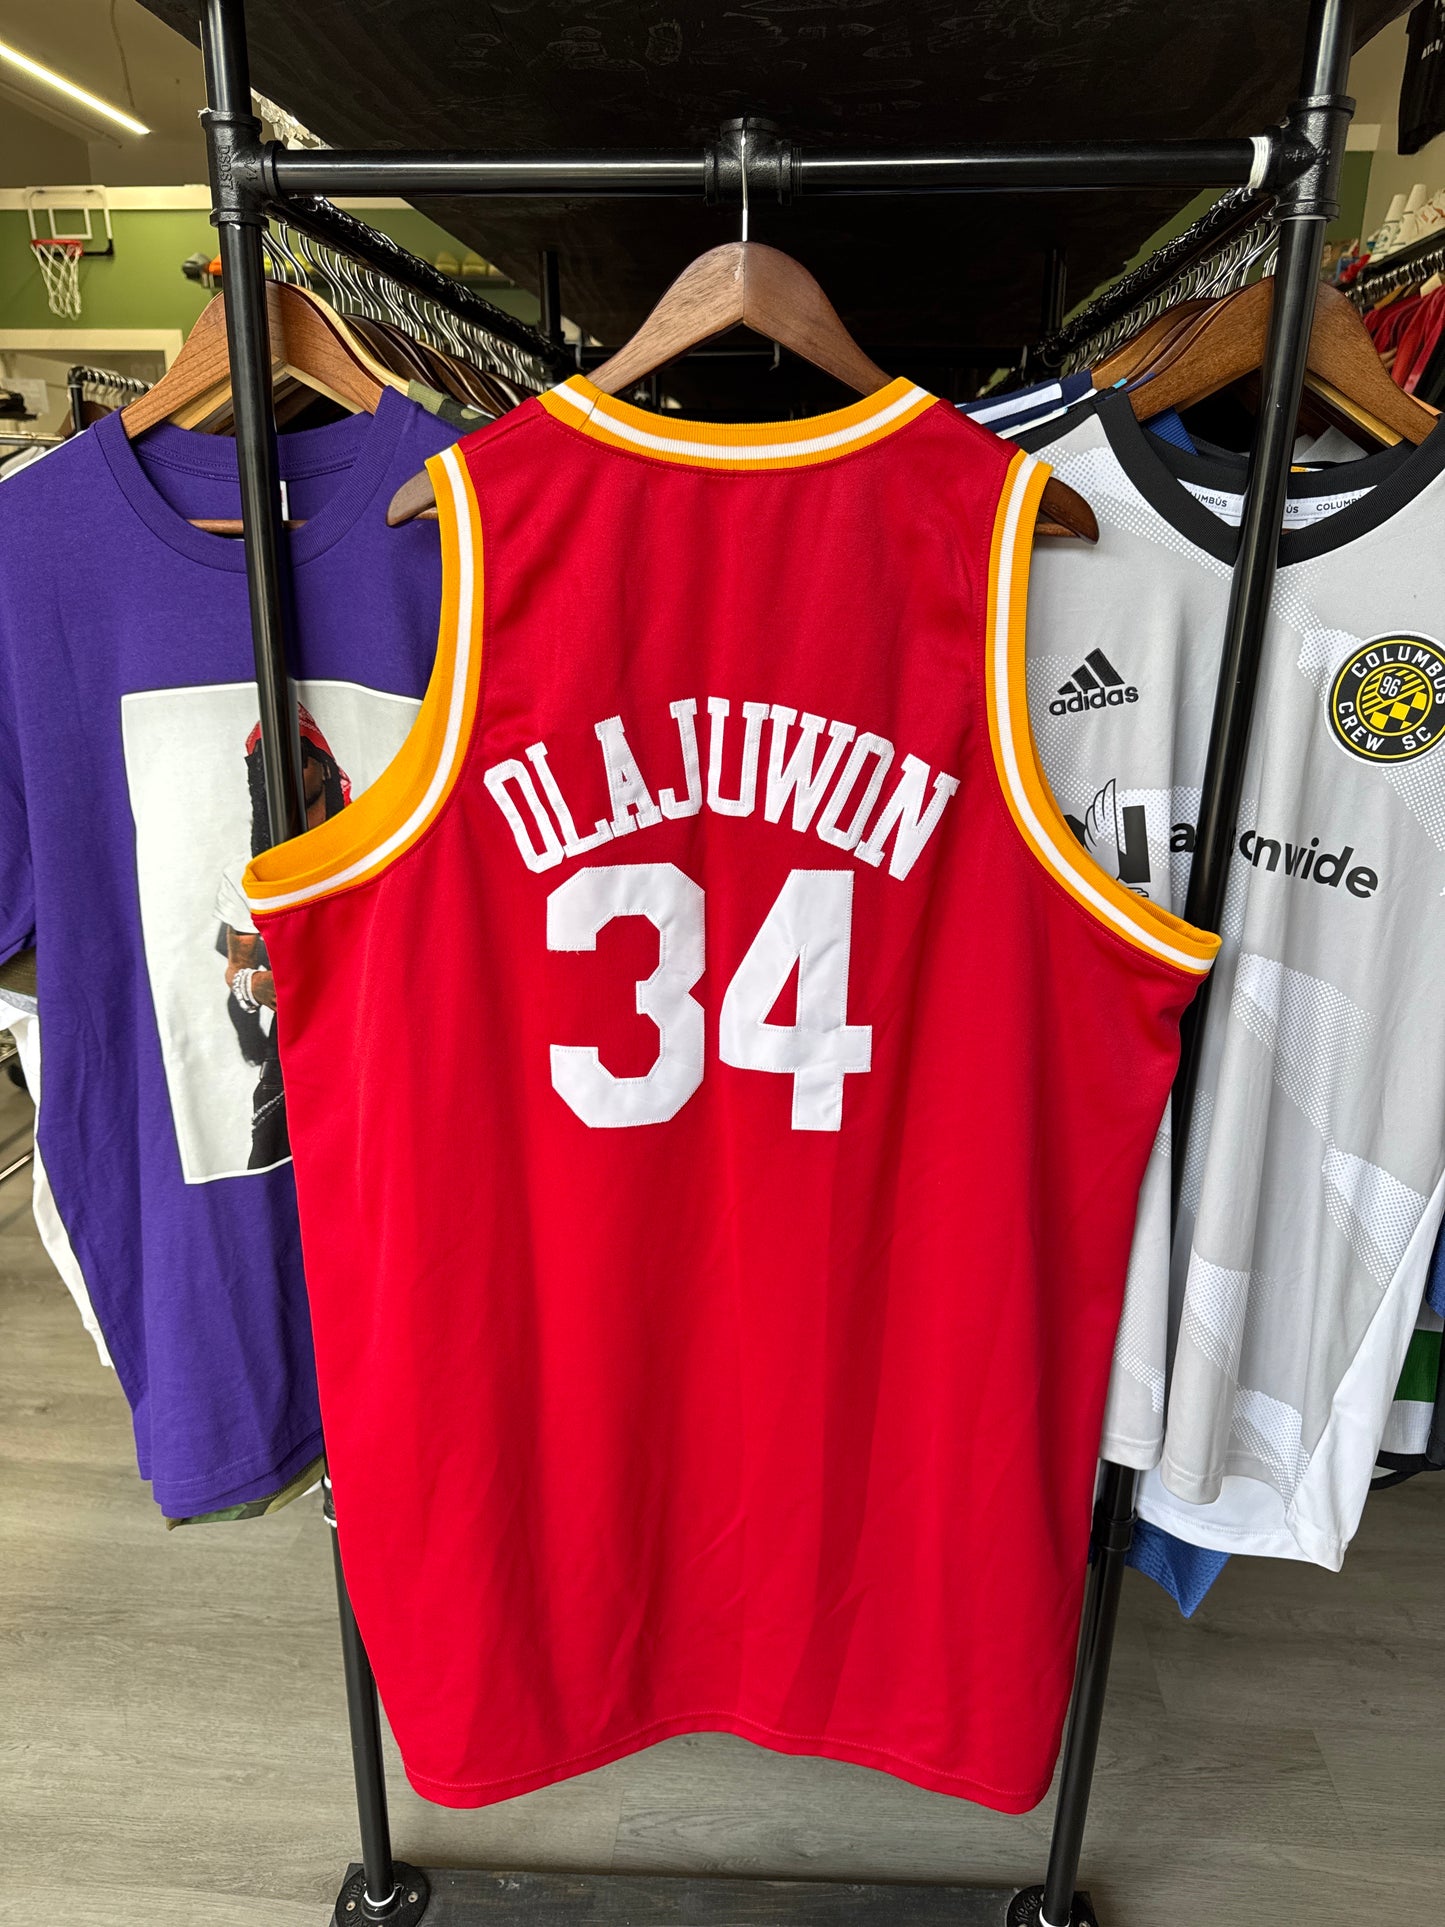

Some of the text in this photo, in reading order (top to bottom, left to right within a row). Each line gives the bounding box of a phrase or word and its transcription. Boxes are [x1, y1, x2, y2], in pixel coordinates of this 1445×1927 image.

[1049, 686, 1139, 716] adidas
[1380, 675, 1401, 697] 96
[1338, 701, 1432, 752] CREW SC
[483, 696, 961, 882] OLAJUWON
[547, 862, 873, 1132] 34
